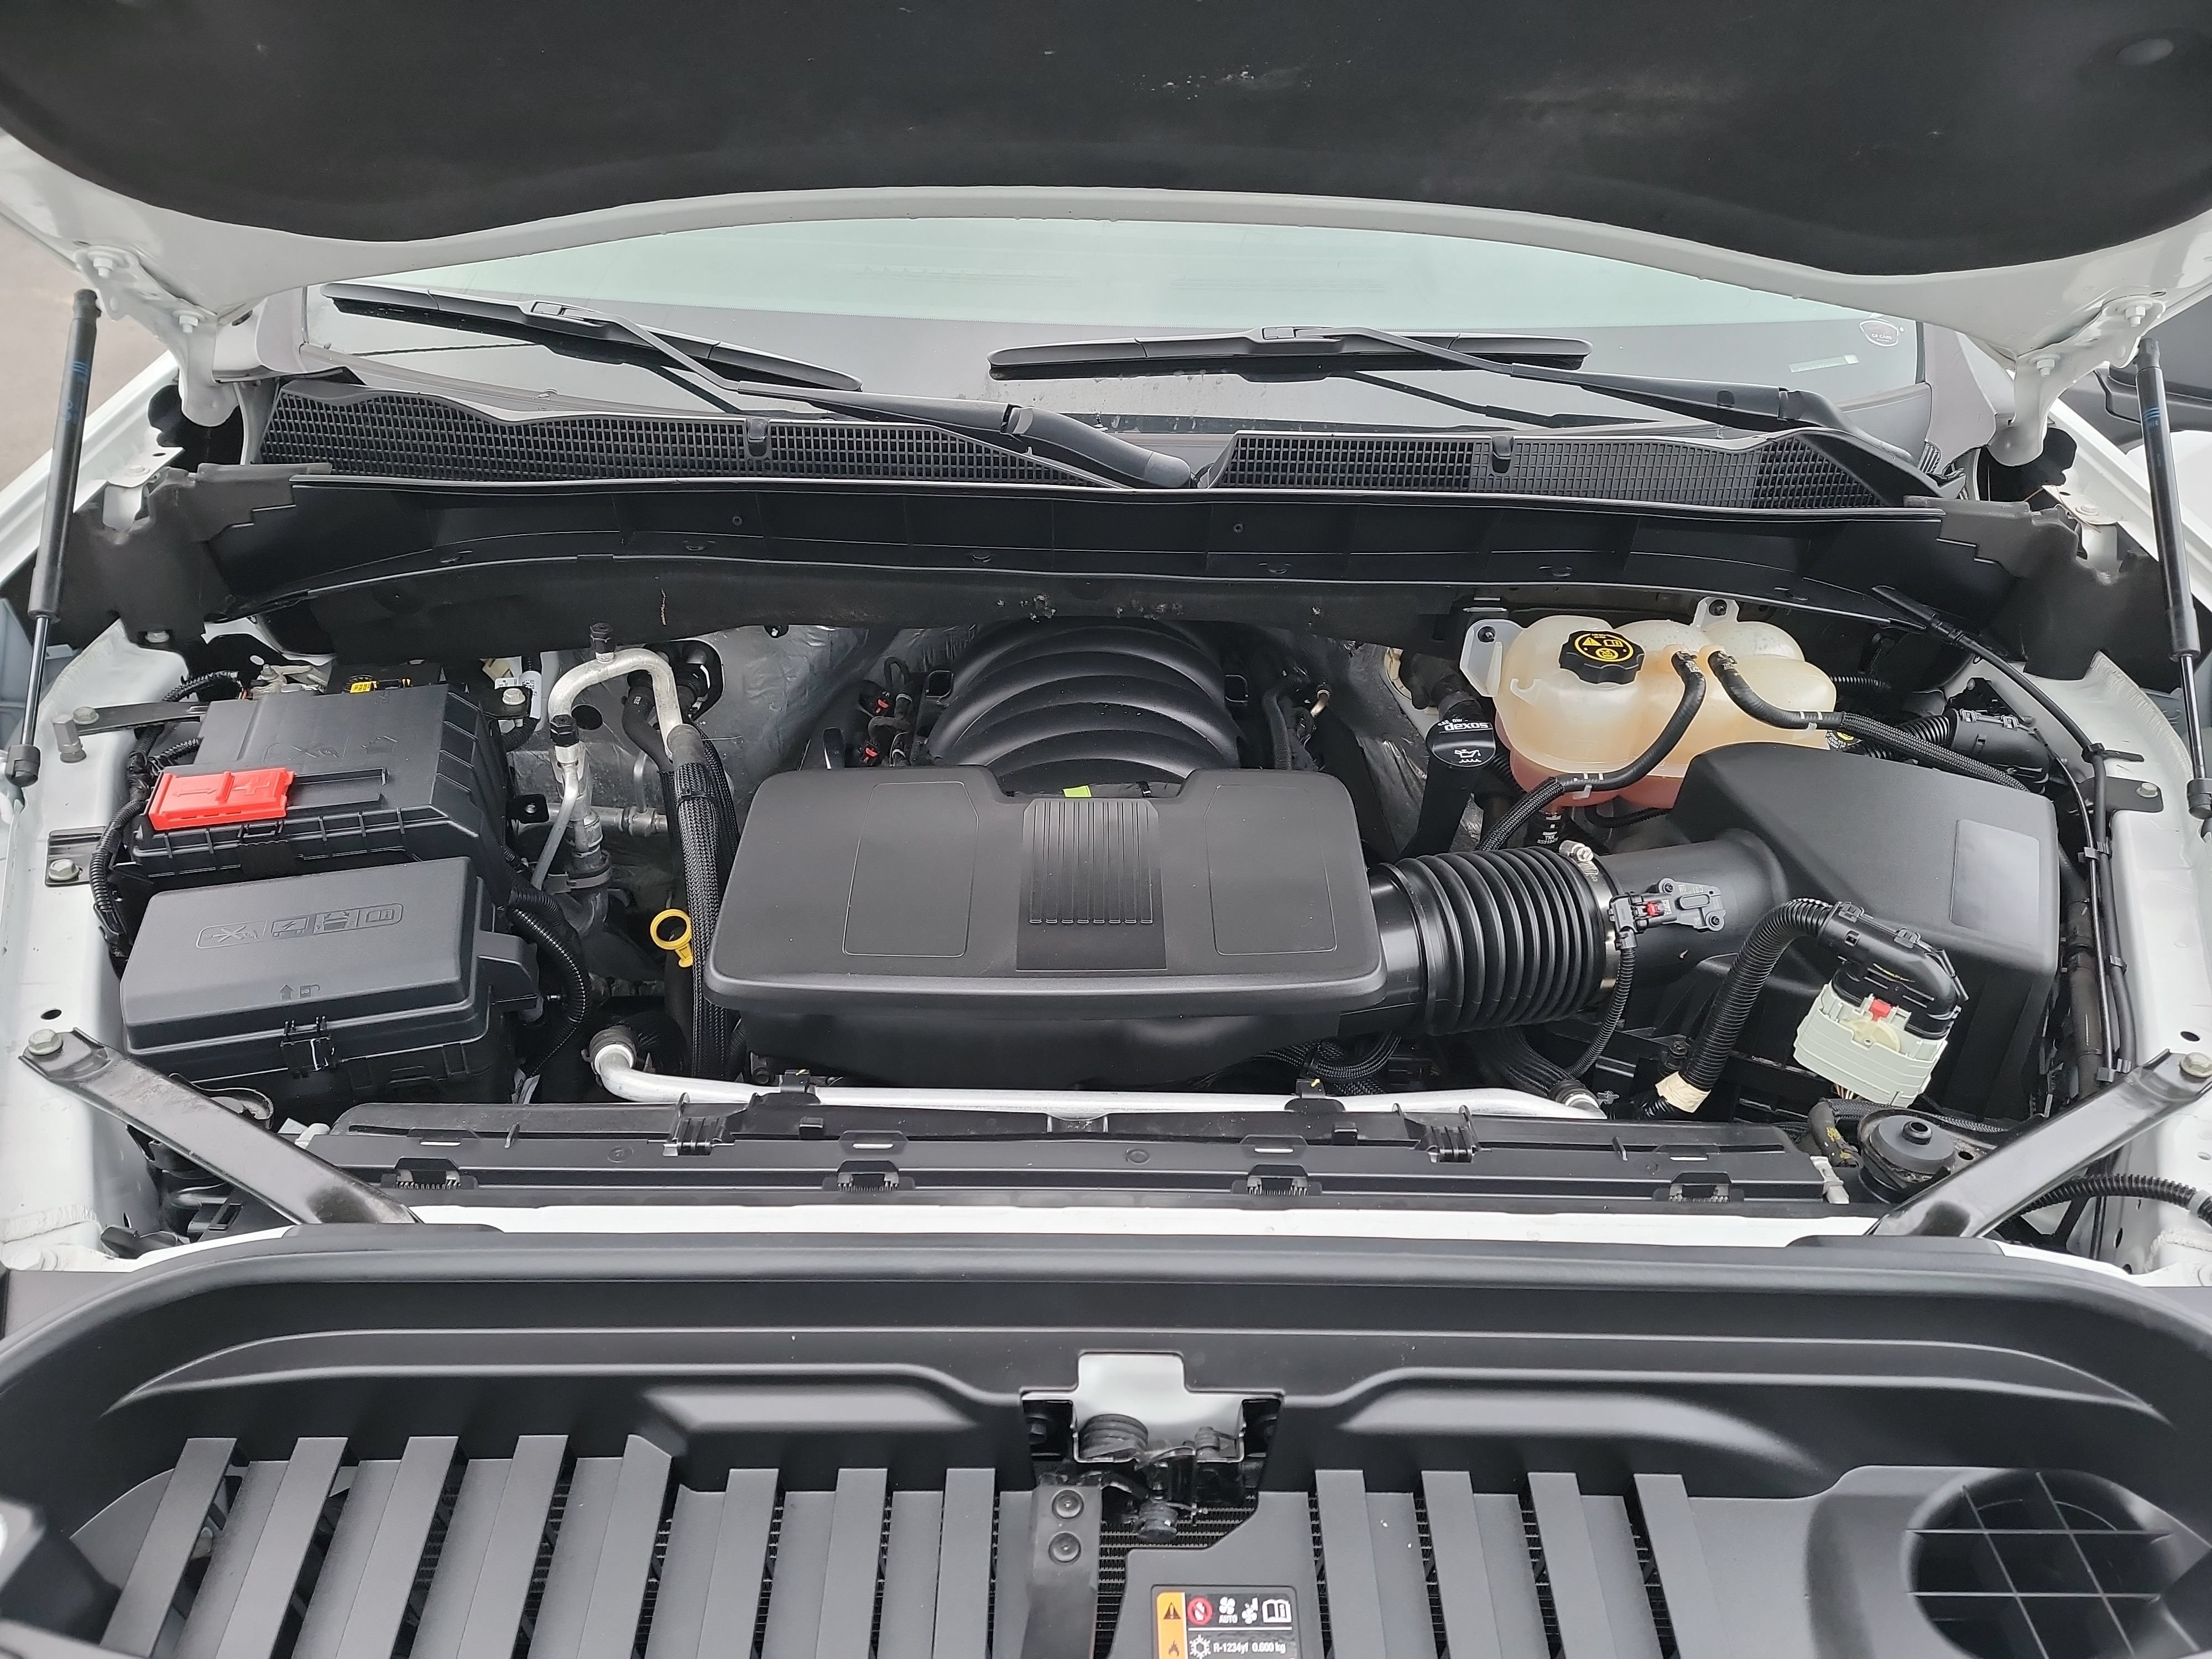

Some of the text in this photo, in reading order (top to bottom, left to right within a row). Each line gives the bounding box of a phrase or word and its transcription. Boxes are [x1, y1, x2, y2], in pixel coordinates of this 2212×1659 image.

[1444, 722, 1488, 731] dexos
[1219, 1614, 1238, 1624] AUTO
[1213, 1642, 1248, 1654] R-1234yf
[1275, 1642, 1286, 1654] kg
